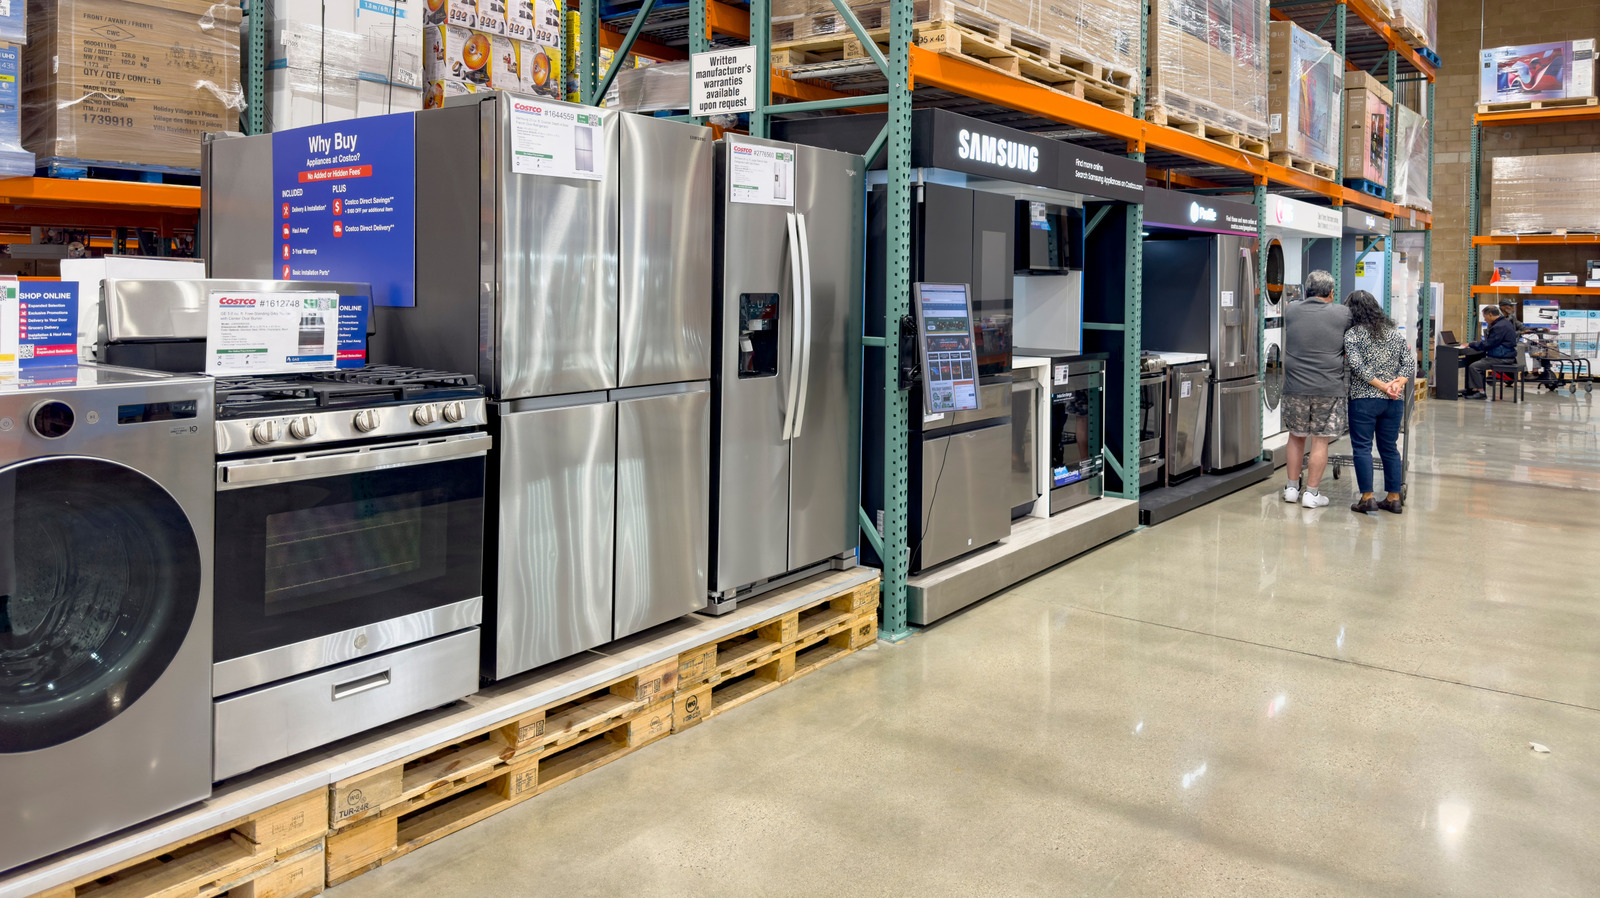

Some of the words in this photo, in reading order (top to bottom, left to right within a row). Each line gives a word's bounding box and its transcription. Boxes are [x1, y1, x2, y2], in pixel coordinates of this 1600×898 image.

[84, 13, 103, 21] FRONT
[108, 17, 127, 25] AVANT
[132, 21, 153, 29] FRENTE
[710, 56, 736, 67] Written
[83, 68, 99, 78] QTY
[696, 64, 752, 79] manufacturer's
[703, 76, 743, 89] warranties
[706, 87, 740, 99] available
[153, 105, 174, 113] Holiday
[514, 103, 542, 113] COSTCO
[544, 110, 574, 120] #1644559
[699, 101, 717, 112] upon
[719, 97, 747, 110] request
[82, 113, 134, 128] 1739918
[309, 135, 331, 155] Why
[334, 132, 357, 152] Buy
[958, 128, 1039, 173] SAMSUNG
[306, 157, 331, 168] Appliances
[338, 153, 360, 162] Costco?
[313, 171, 327, 179] Added
[333, 169, 348, 178] Hidden
[1075, 170, 1087, 179] Search
[1088, 173, 1104, 184] Samsung
[1104, 176, 1121, 186] Appliances
[282, 188, 303, 198] INCLUDED
[332, 184, 346, 193] PLUS
[339, 803, 369, 818] TUR-24R
